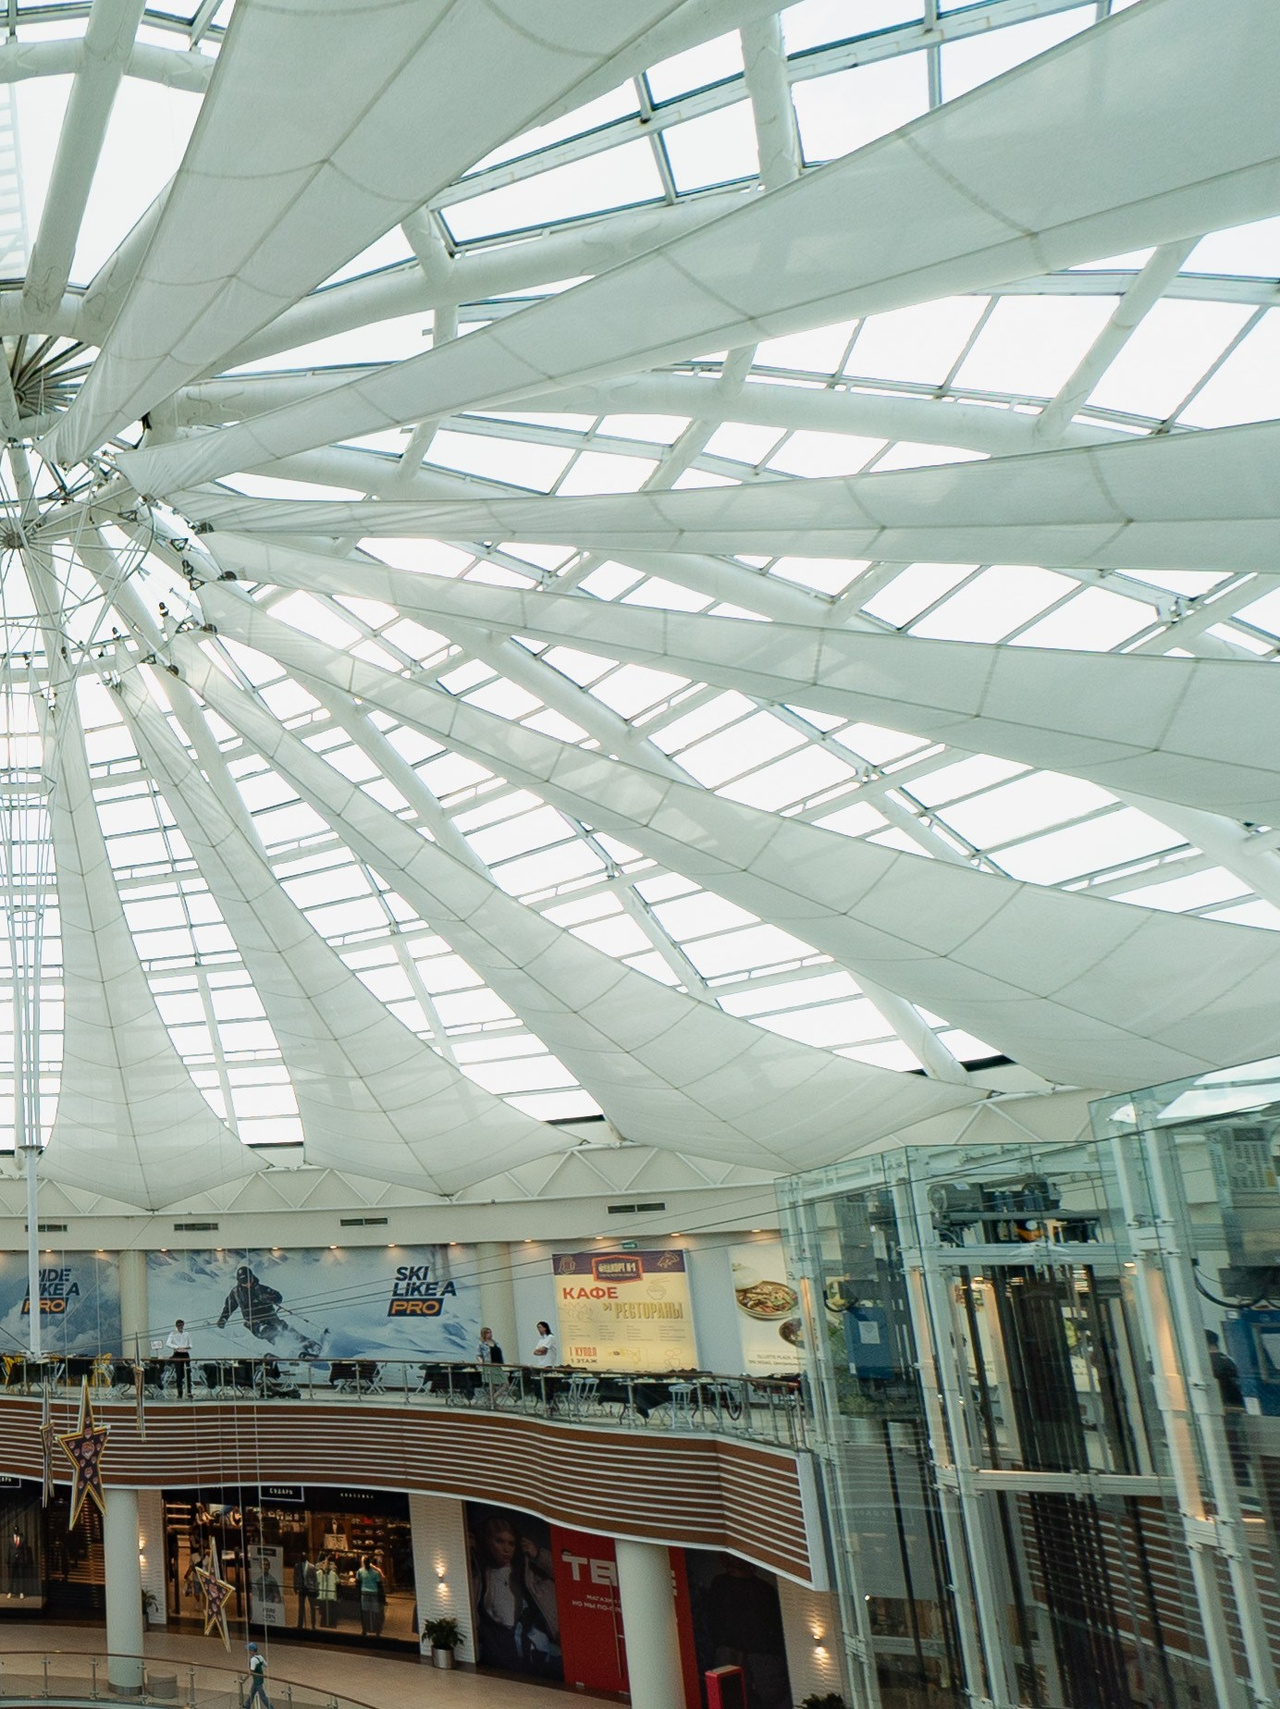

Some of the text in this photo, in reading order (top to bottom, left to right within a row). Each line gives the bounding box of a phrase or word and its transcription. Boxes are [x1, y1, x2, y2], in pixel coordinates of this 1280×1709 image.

[38, 1268, 71, 1282] IDE
[394, 1265, 430, 1281] SKI
[65, 1282, 80, 1296] A
[392, 1280, 457, 1297] LIKE A
[562, 1286, 618, 1300] КАФЕ
[391, 1300, 440, 1314] PRO
[615, 1301, 684, 1319] РЕСТОРАНЫ
